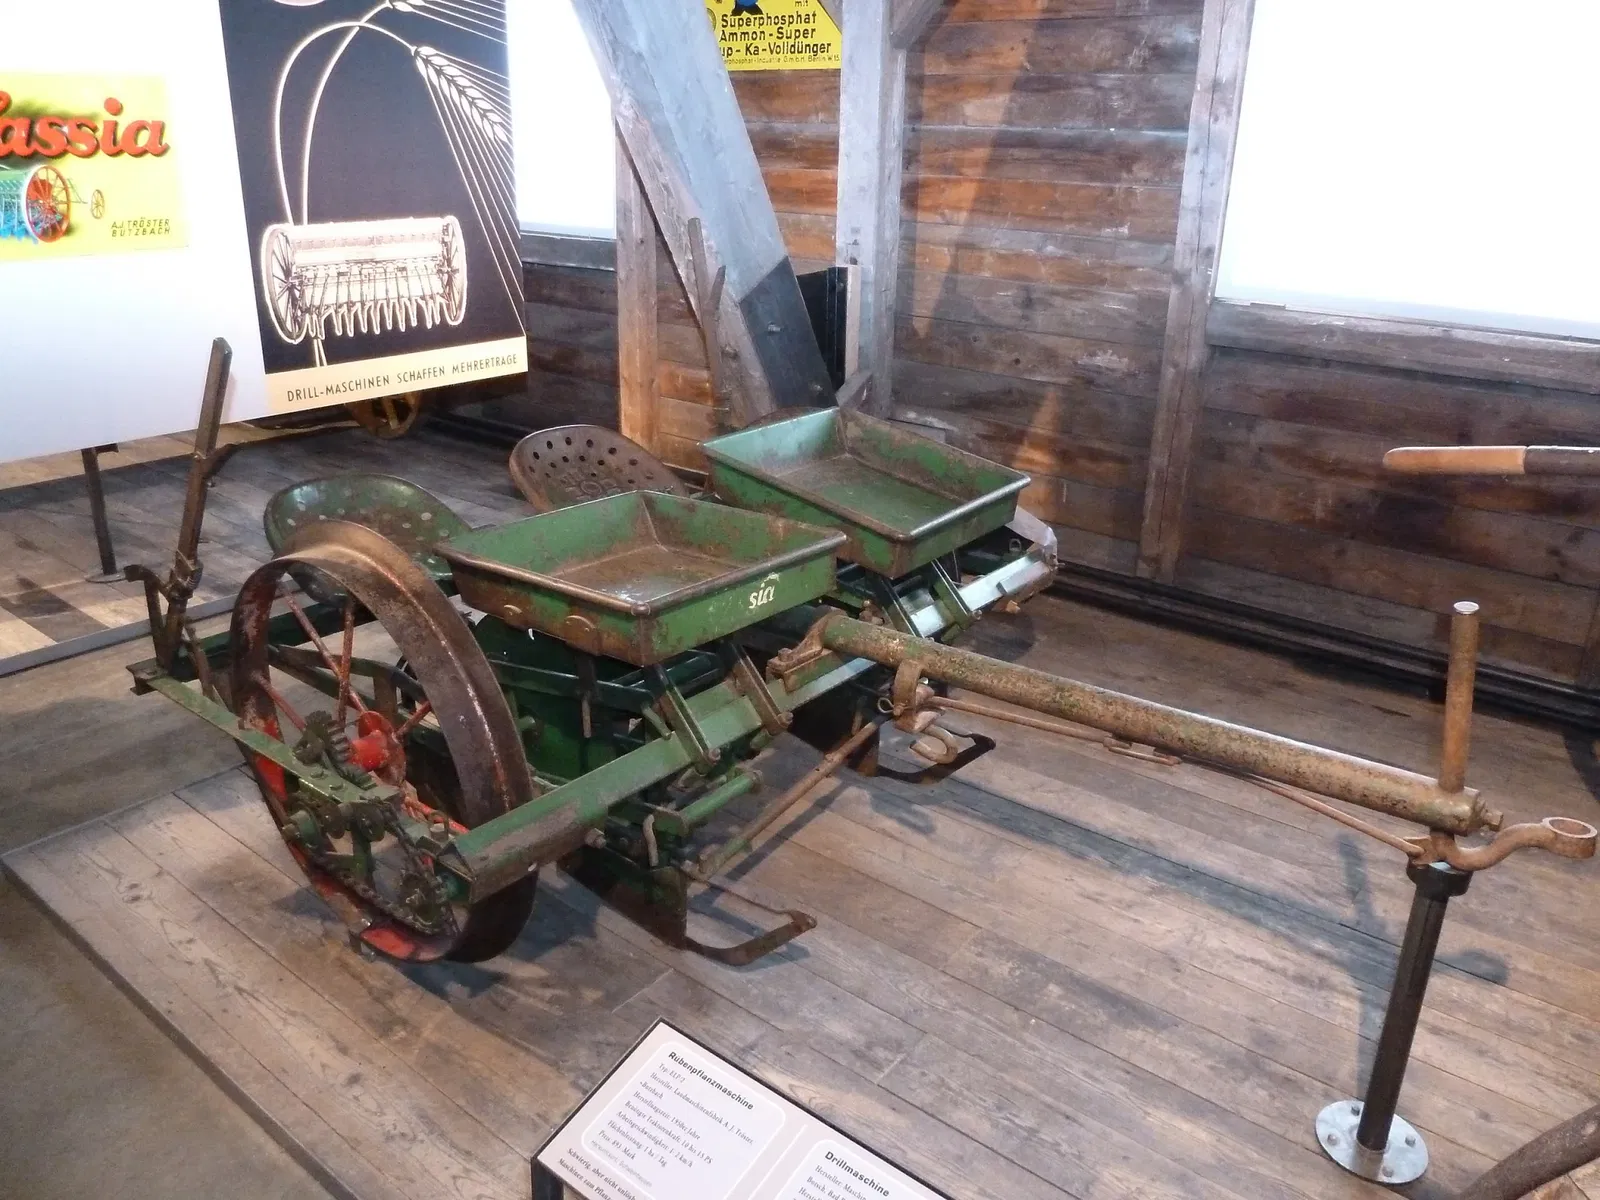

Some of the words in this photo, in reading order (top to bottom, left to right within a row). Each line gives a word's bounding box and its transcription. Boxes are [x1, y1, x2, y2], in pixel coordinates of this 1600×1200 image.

[721, 11, 817, 30] Superphosphat
[720, 42, 832, 58] up-Ka-Volldünger
[0, 93, 170, 158] assia
[111, 227, 171, 237] BUTZBACH
[127, 216, 170, 229] TRÖSTER
[287, 374, 390, 402] DRILL-MASCHINEN
[396, 365, 446, 384] SCHAFFEN
[559, 1158, 584, 1180] Maschinen
[584, 1178, 595, 1188] zum
[592, 1167, 604, 1178] aber
[604, 1176, 618, 1188] nicht
[824, 1151, 890, 1197] Drillmaschine
